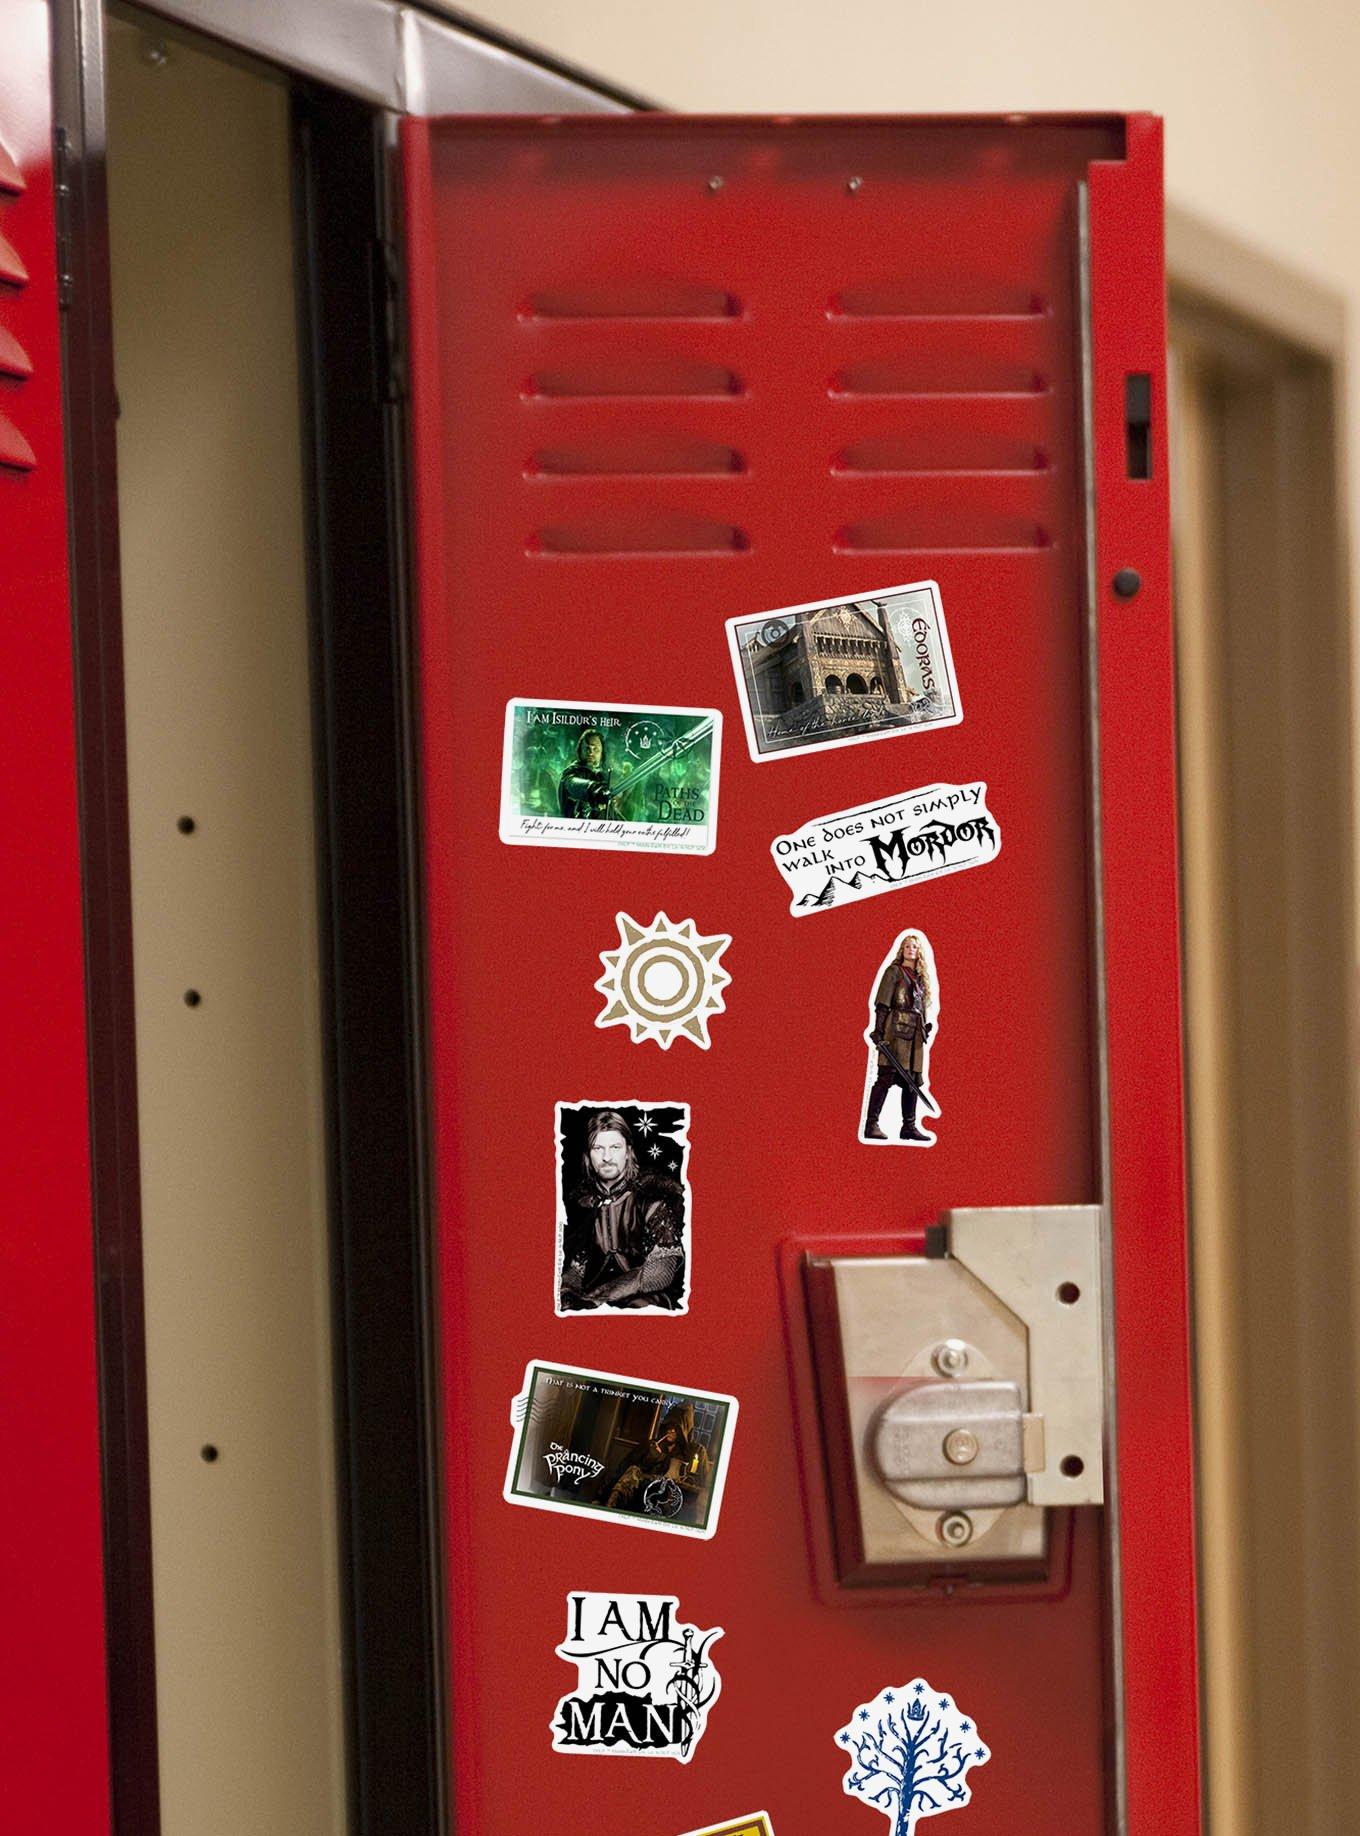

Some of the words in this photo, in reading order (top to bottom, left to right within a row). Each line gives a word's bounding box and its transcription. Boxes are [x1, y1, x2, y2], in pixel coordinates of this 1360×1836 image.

[526, 710, 532, 724] I
[532, 712, 550, 724] AM
[551, 712, 598, 726] ISILDUR'S
[599, 717, 622, 727] HEIR
[655, 783, 700, 800] PATHS
[659, 800, 705, 822] DEAD
[776, 836, 817, 855] ONE
[823, 822, 864, 843] DOES
[870, 809, 906, 829] NOT
[913, 786, 982, 816] SIMPLY
[520, 818, 543, 834] Fight
[541, 822, 553, 835] for
[567, 821, 585, 831] and
[590, 823, 606, 833] will
[605, 822, 624, 834] hold
[620, 829, 637, 838] your
[782, 849, 835, 873] WALK
[825, 855, 866, 876] INTO
[859, 816, 996, 881] MORDOR
[545, 1377, 564, 1386] THAT
[632, 1394, 649, 1403] YOU
[570, 1596, 586, 1642] I
[597, 1600, 674, 1642] AM
[594, 1658, 651, 1690] NO
[567, 1702, 678, 1744] MAN
